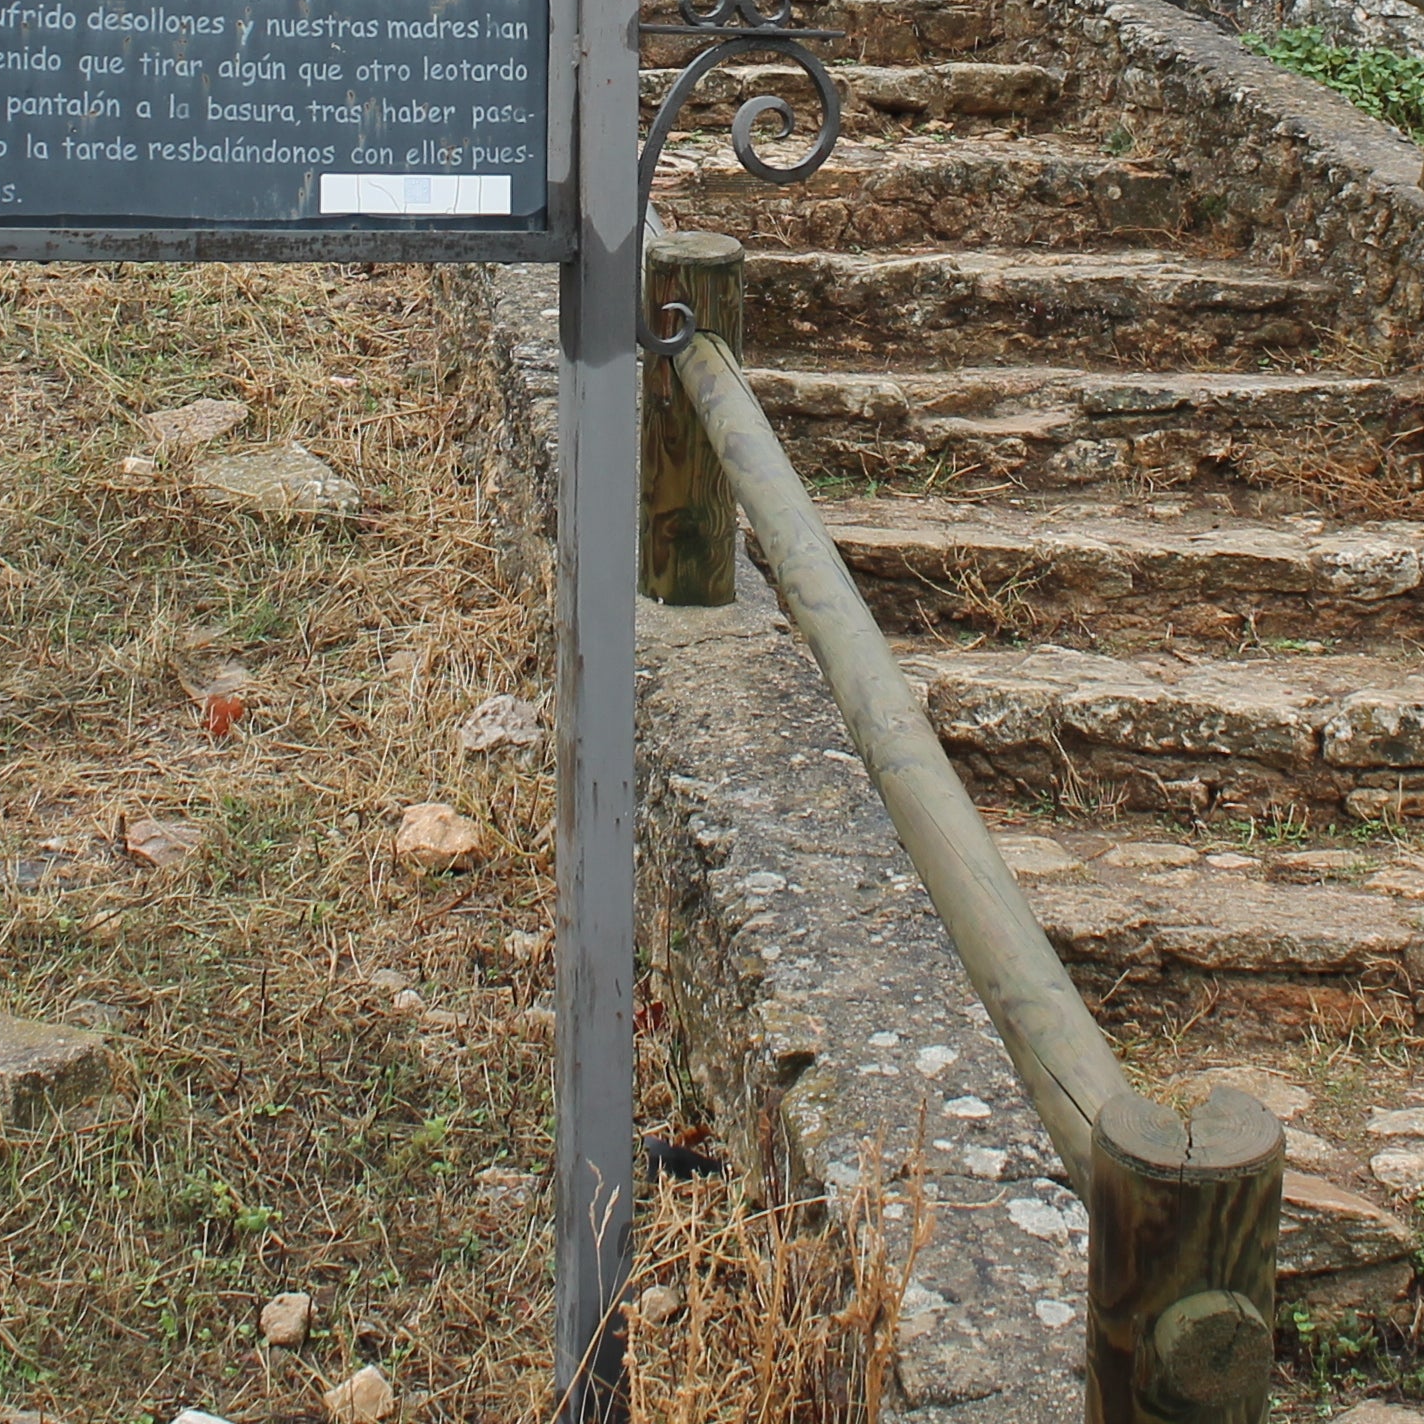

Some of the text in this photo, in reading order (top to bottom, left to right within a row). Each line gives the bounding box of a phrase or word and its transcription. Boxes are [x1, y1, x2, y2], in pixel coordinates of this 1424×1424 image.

[87, 5, 225, 35] desollones
[239, 18, 253, 48] y
[266, 14, 378, 39] nuestras
[387, 13, 479, 39] madres
[78, 52, 126, 80] que
[139, 50, 202, 76] tirar
[218, 53, 286, 85] algún
[299, 61, 343, 86] que
[356, 60, 410, 82] otro
[423, 57, 528, 82] leotardo
[6, 91, 120, 120] pantalón
[136, 99, 151, 117] a
[168, 90, 189, 117] la
[207, 96, 302, 127] basura,
[307, 100, 362, 125] tras
[382, 98, 455, 123] haber
[471, 106, 535, 129] pasa-
[26, 133, 49, 160] la
[61, 137, 137, 162] tarde
[148, 136, 335, 165] resbalándonos
[350, 142, 393, 166] con
[406, 140, 463, 165] ellos
[471, 144, 534, 169] pues-
